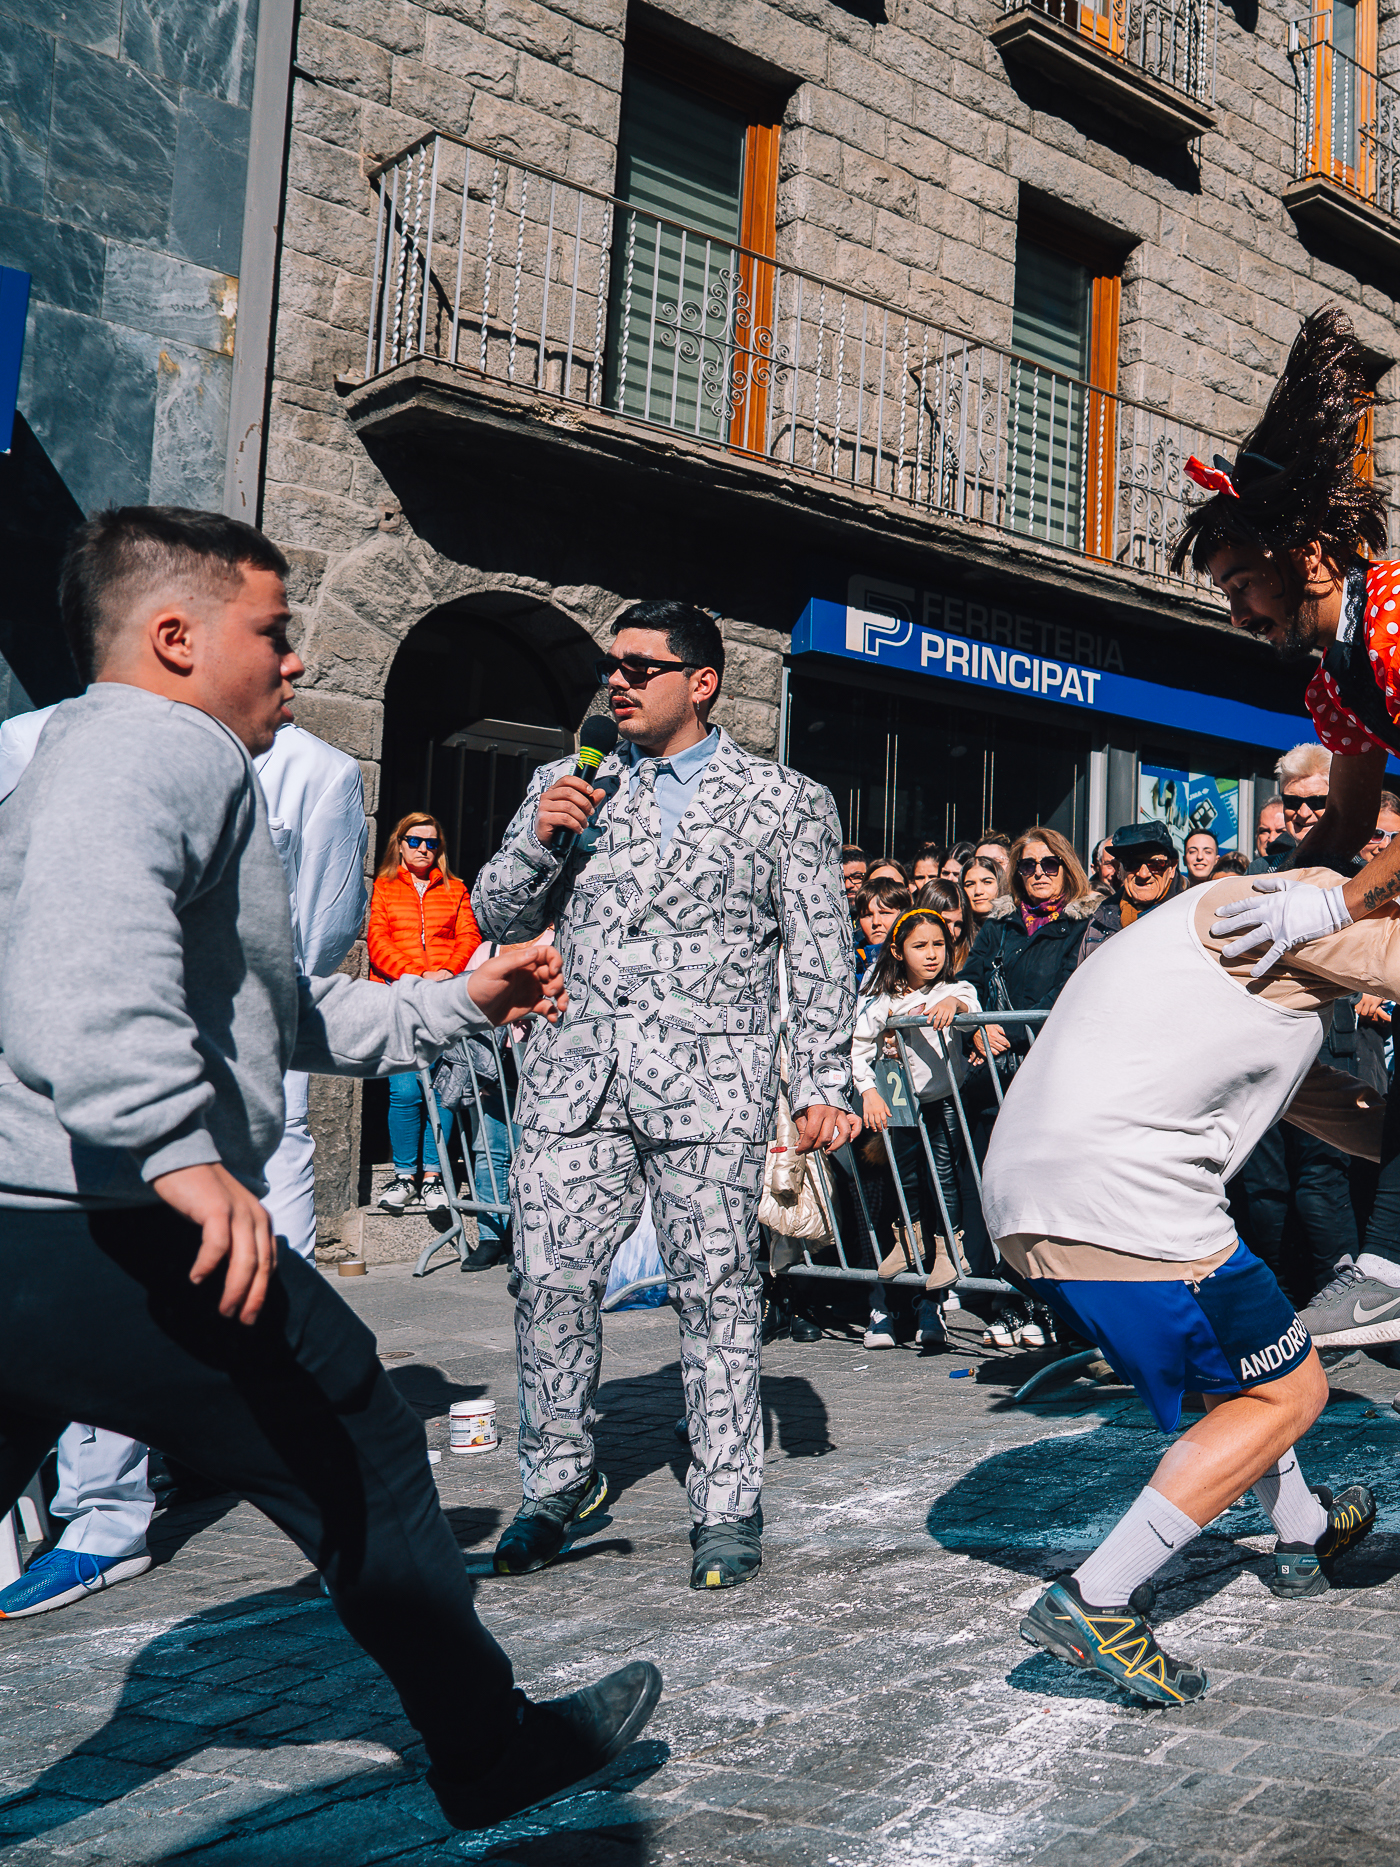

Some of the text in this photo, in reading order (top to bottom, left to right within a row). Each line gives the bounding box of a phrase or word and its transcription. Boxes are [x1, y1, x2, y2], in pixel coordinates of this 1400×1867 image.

[922, 590, 1125, 672] FERRETERIA
[920, 632, 1102, 704] PRINCIPAT
[887, 1072, 907, 1106] 2
